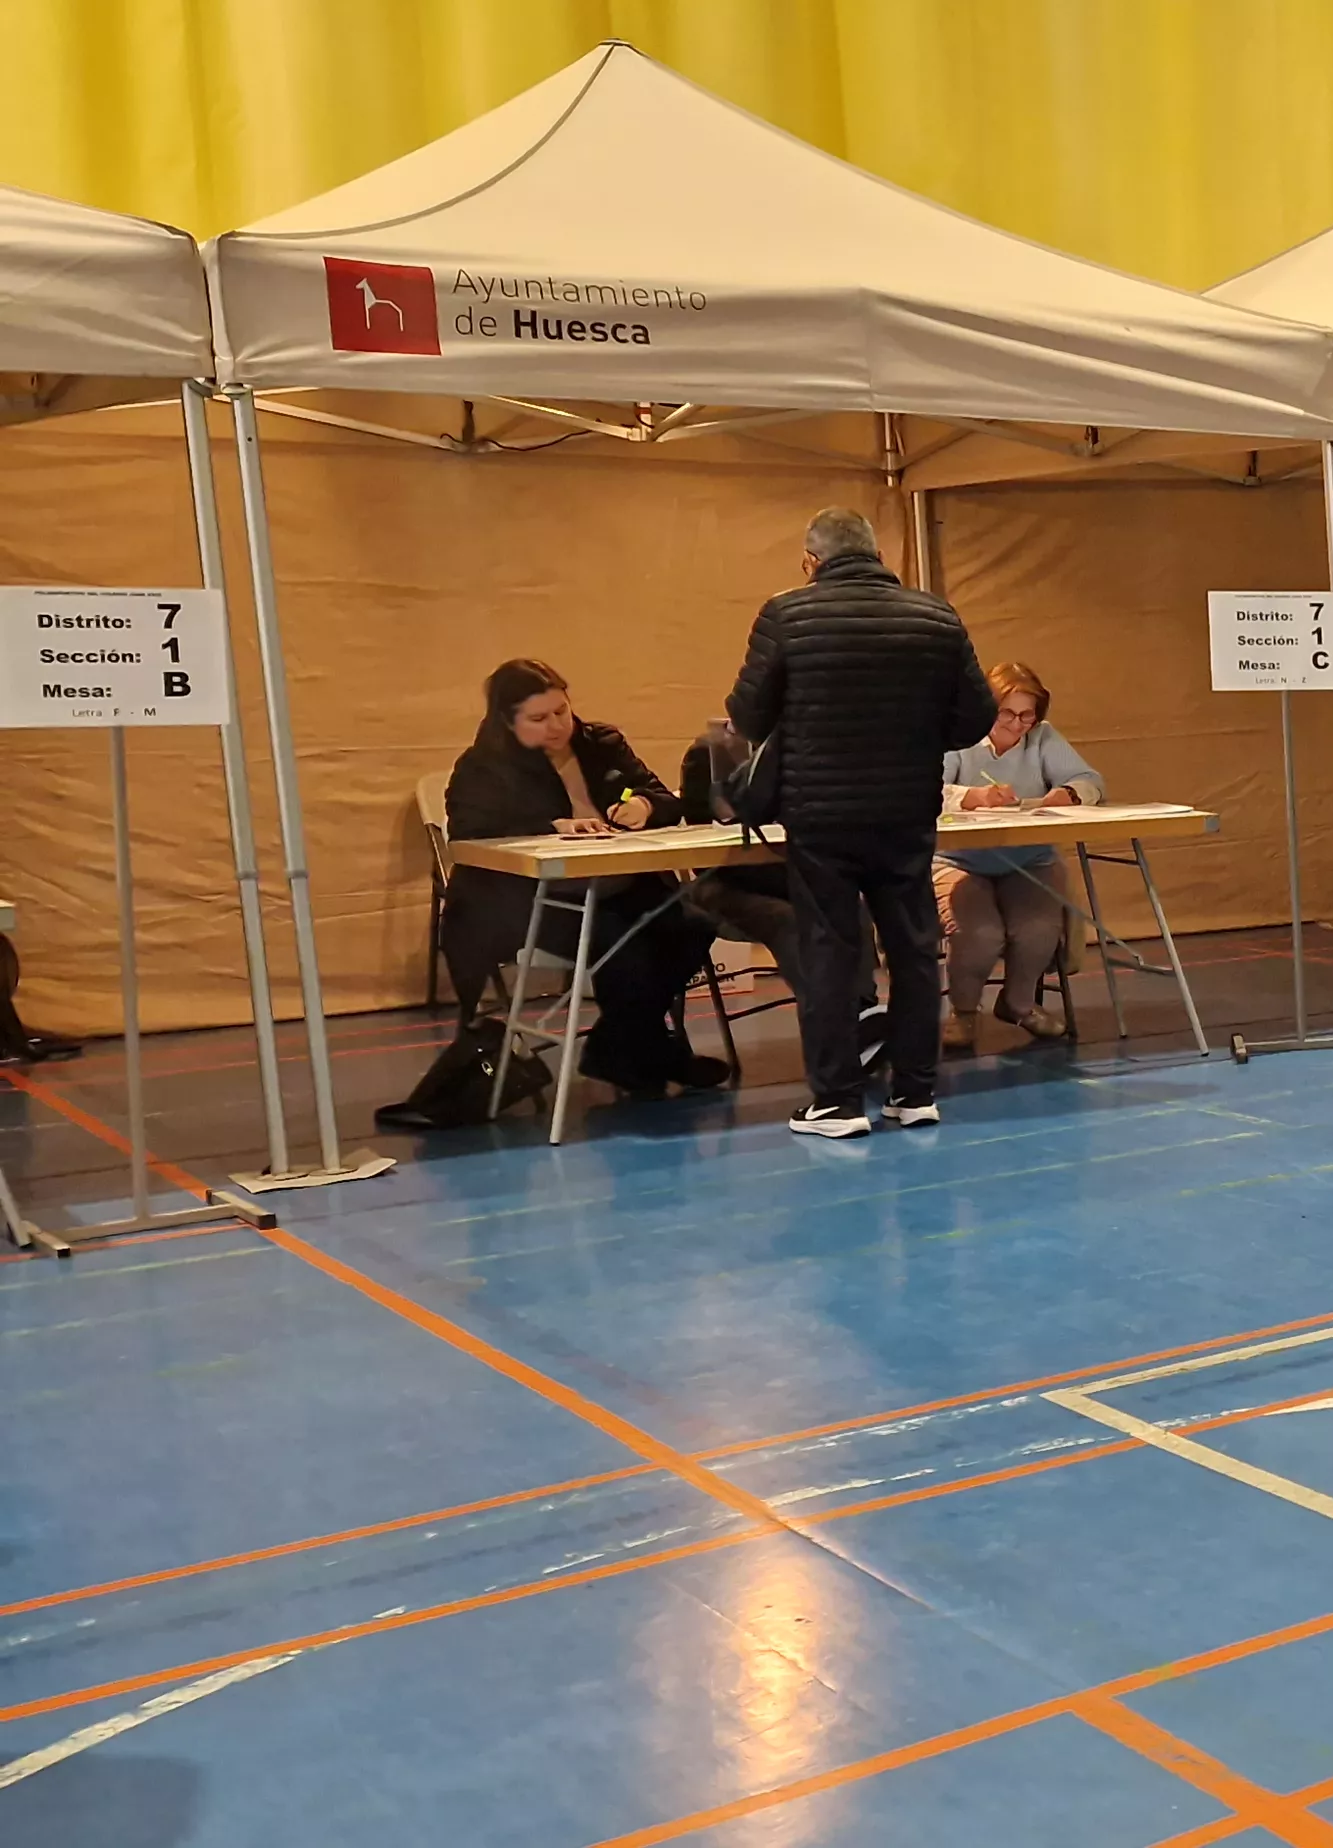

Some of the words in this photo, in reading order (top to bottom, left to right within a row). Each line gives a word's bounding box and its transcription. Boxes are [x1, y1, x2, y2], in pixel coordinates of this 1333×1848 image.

[452, 268, 707, 311] Ayuntamiento
[454, 306, 497, 337] de
[513, 309, 651, 345] Huesca
[37, 614, 132, 628] Distrito:
[157, 603, 181, 629] 7
[1236, 611, 1293, 621] Distrito:
[1309, 603, 1324, 621] 7
[1238, 635, 1298, 646] Sección:
[1311, 627, 1322, 645] 1
[40, 649, 141, 663] Sección:
[161, 637, 180, 663] 1
[1238, 660, 1280, 670] Mesa:
[1312, 651, 1329, 669] C
[42, 684, 112, 698] Mesa:
[163, 671, 191, 697] B
[144, 707, 156, 717] M
